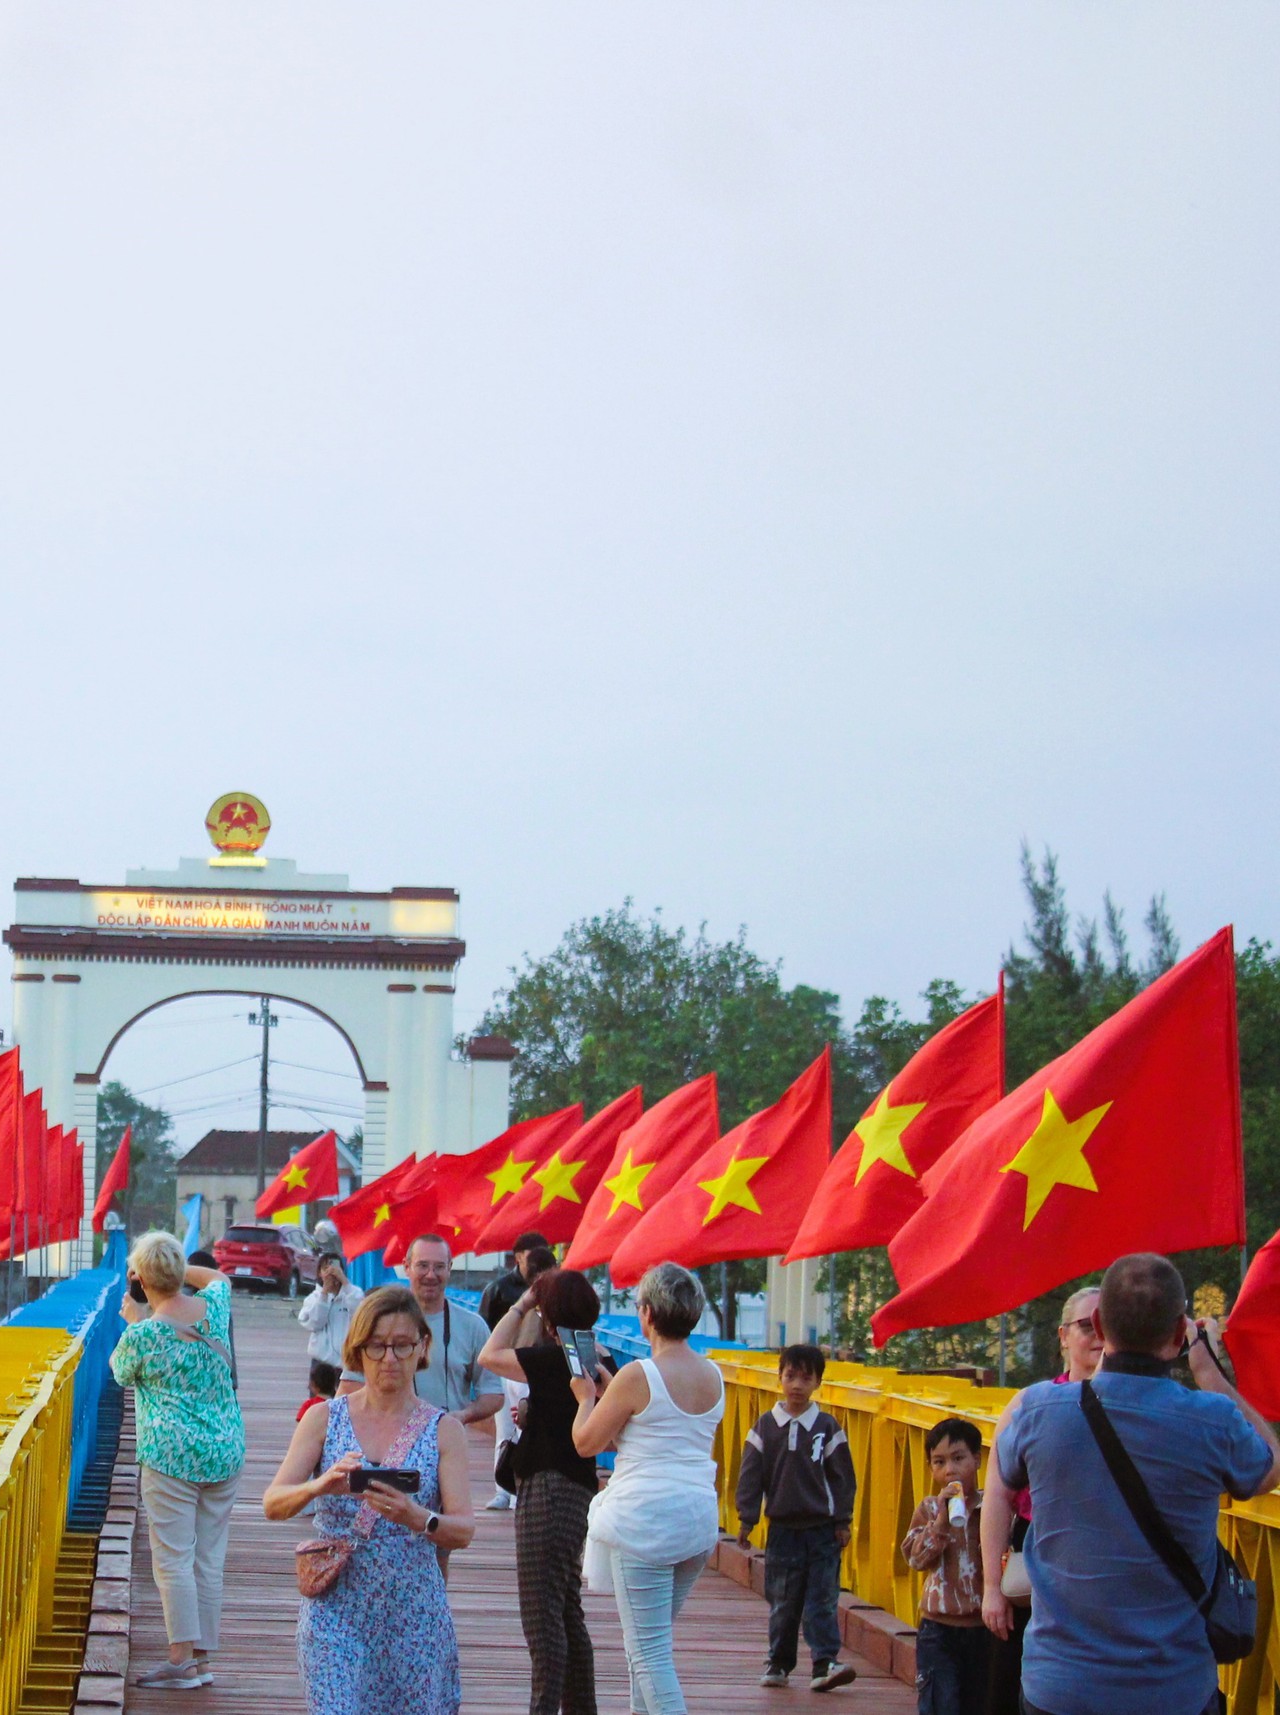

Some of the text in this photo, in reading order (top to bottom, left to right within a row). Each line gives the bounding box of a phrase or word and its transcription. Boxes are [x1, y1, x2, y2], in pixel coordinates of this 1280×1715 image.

[166, 900, 192, 910] NAM
[97, 912, 125, 929] ĐỘC
[303, 919, 338, 931] MUÔN
